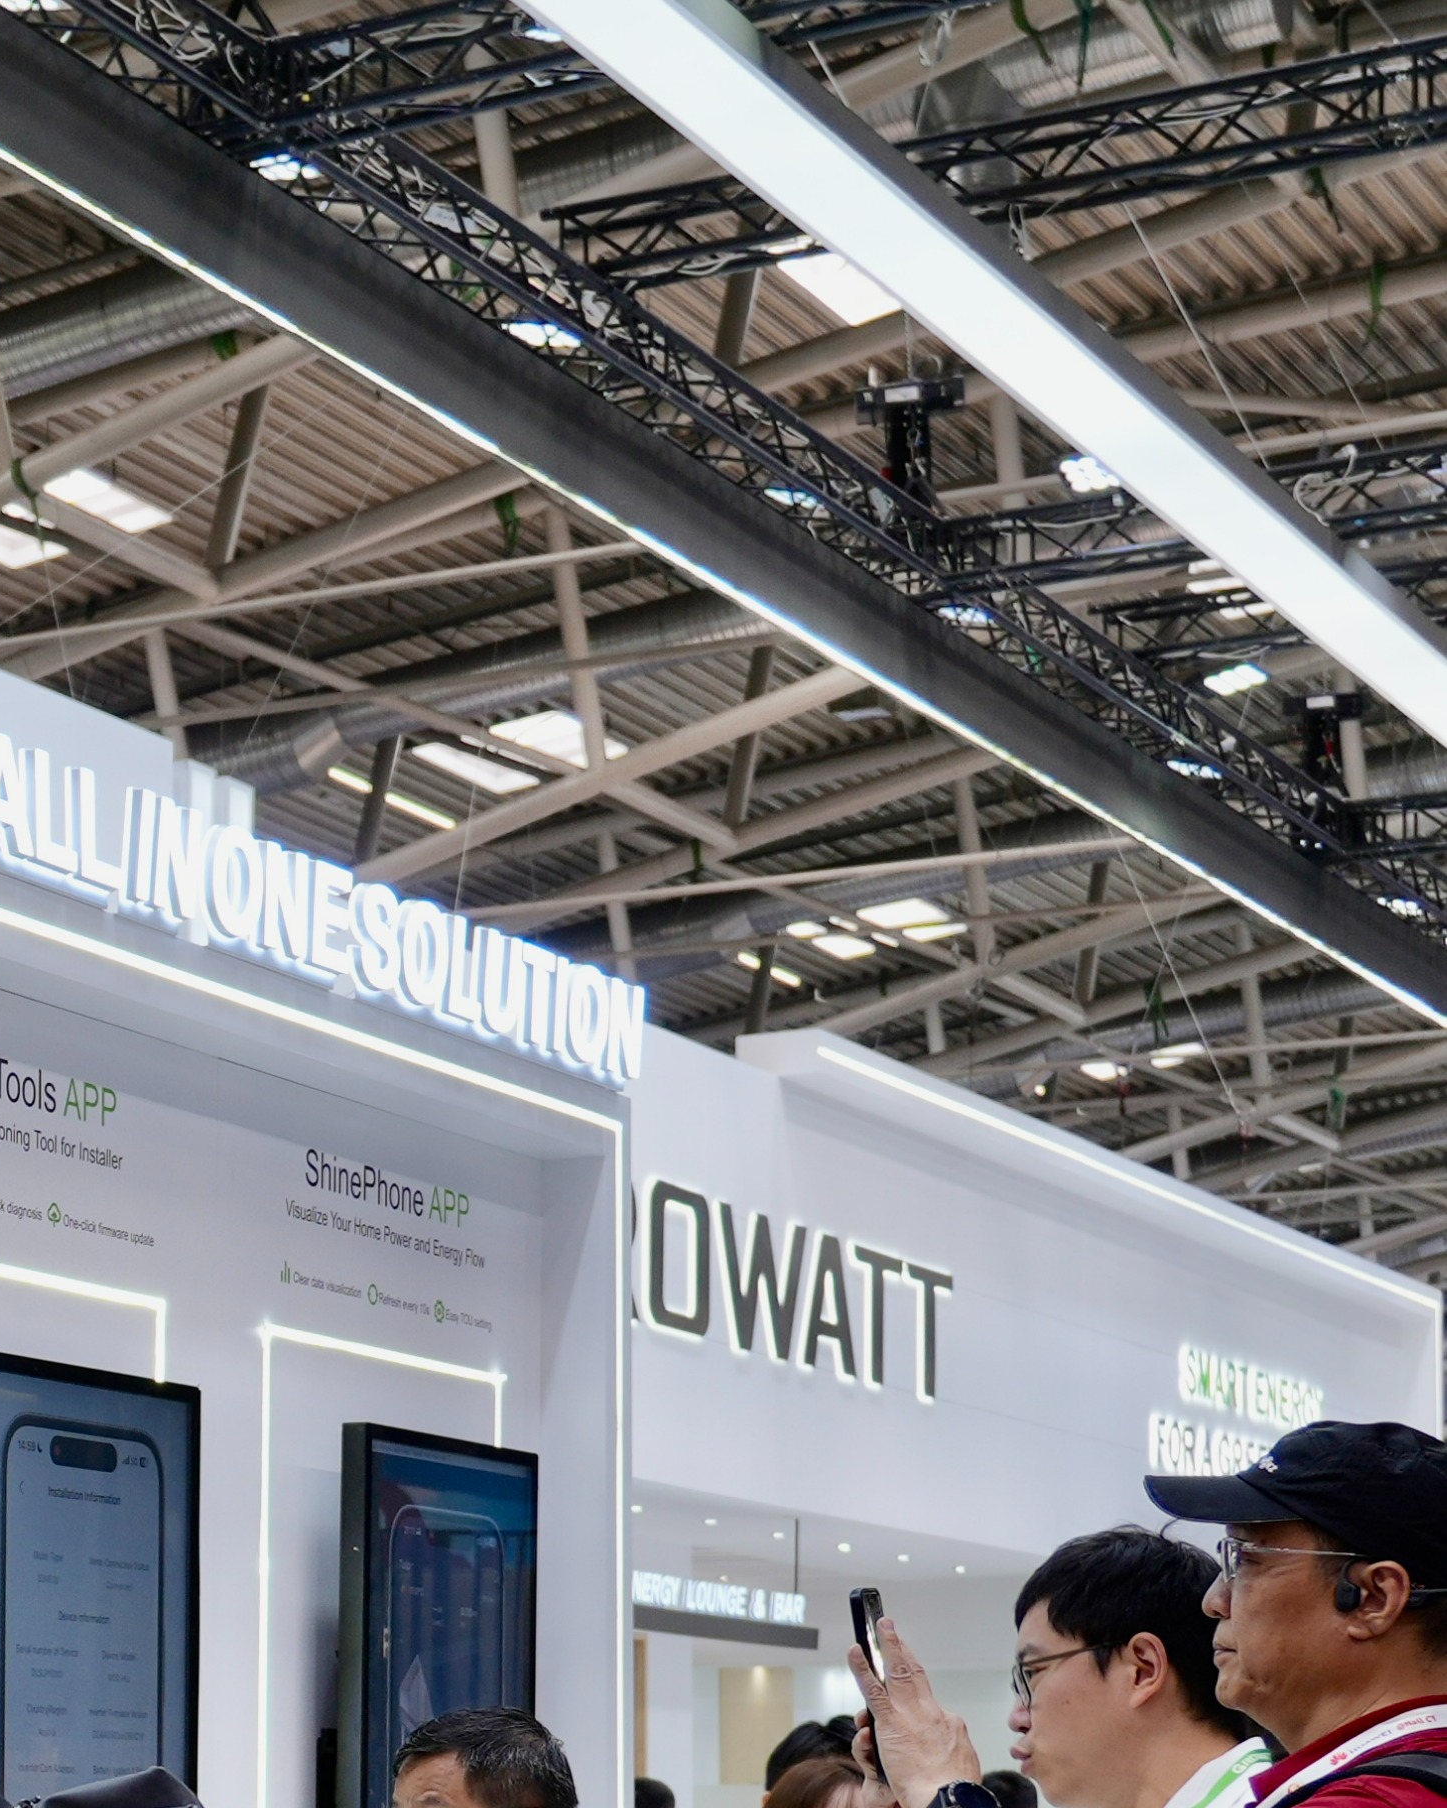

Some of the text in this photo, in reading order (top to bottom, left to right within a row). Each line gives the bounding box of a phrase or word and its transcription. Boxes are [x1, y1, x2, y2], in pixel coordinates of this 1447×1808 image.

[121, 786, 205, 920] IN
[204, 823, 357, 981] ONE
[349, 882, 646, 1080] SOLUTION
[63, 1077, 117, 1127] APP
[34, 1129, 57, 1154] Tool
[61, 1136, 76, 1158] for
[79, 1141, 123, 1171] Installer
[6, 1201, 43, 1221] diagnosis
[305, 1148, 470, 1228] ShinePhone APP
[63, 1213, 155, 1248] One-click firmware update
[285, 1197, 485, 1269] Visualize Your Home Power and Energy Flow
[293, 1270, 310, 1286] Clear
[310, 1276, 325, 1291] data
[631, 1178, 954, 1400] OWATT
[1183, 1347, 1324, 1428] SMART ENERGY
[1156, 1415, 1196, 1475] FOR
[47, 1485, 84, 1501] Installation
[682, 1578, 748, 1616] LOUNGE
[749, 1587, 767, 1620] &
[769, 1591, 806, 1625] BAR
